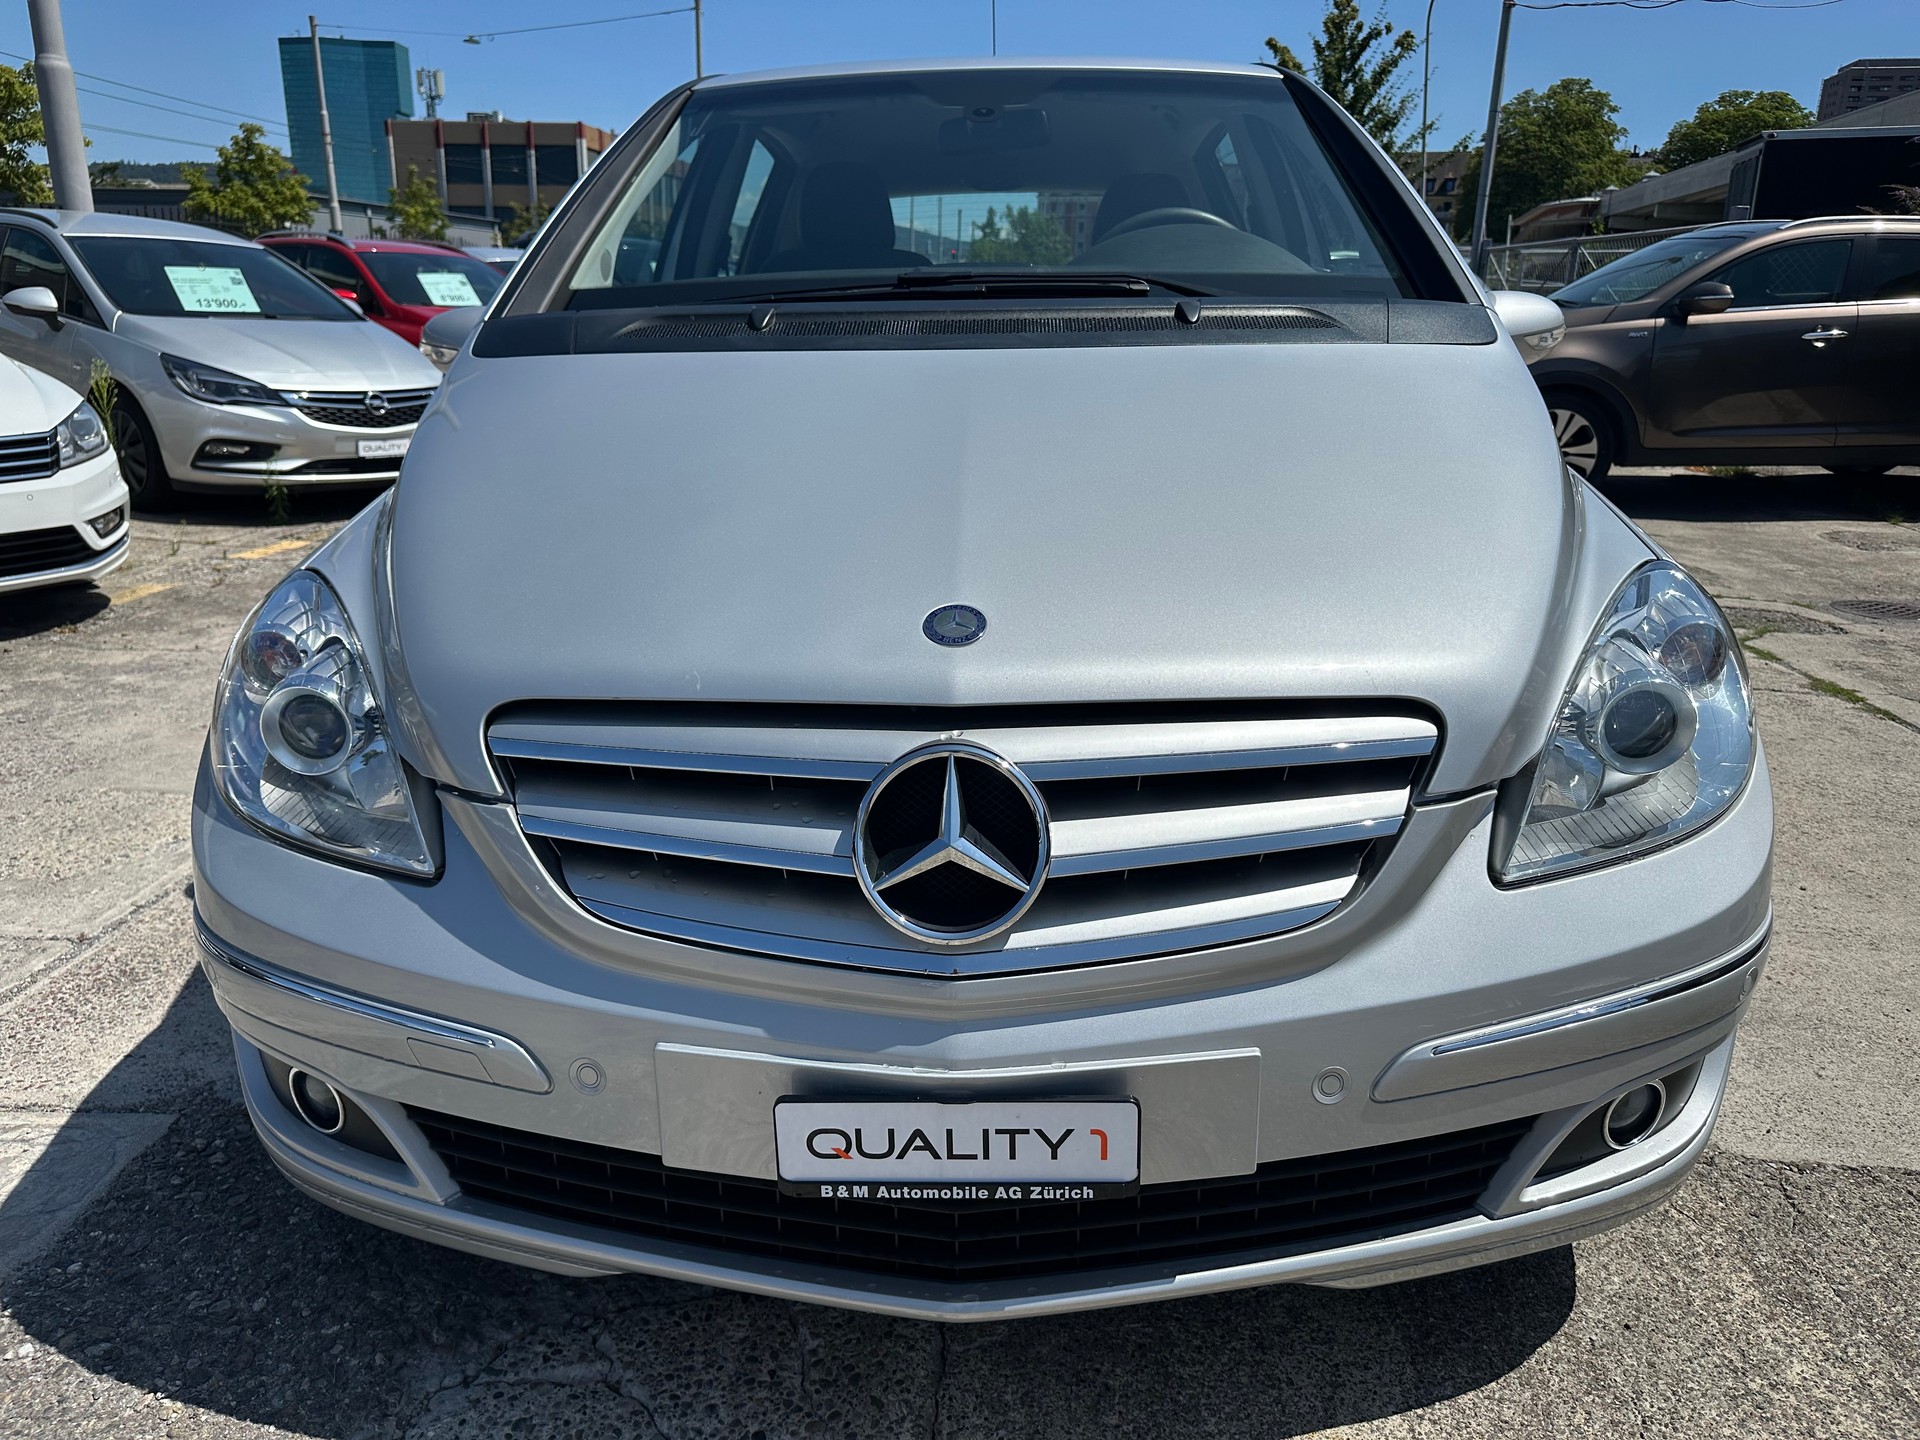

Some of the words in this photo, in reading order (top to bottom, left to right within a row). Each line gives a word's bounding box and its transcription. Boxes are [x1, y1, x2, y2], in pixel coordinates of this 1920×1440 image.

[806, 1128, 1076, 1161] QUALITY
[1090, 1128, 1108, 1161] 1
[876, 1185, 989, 1199] Automobile
[994, 1186, 1022, 1200] AG
[1030, 1185, 1094, 1199] Zürich
